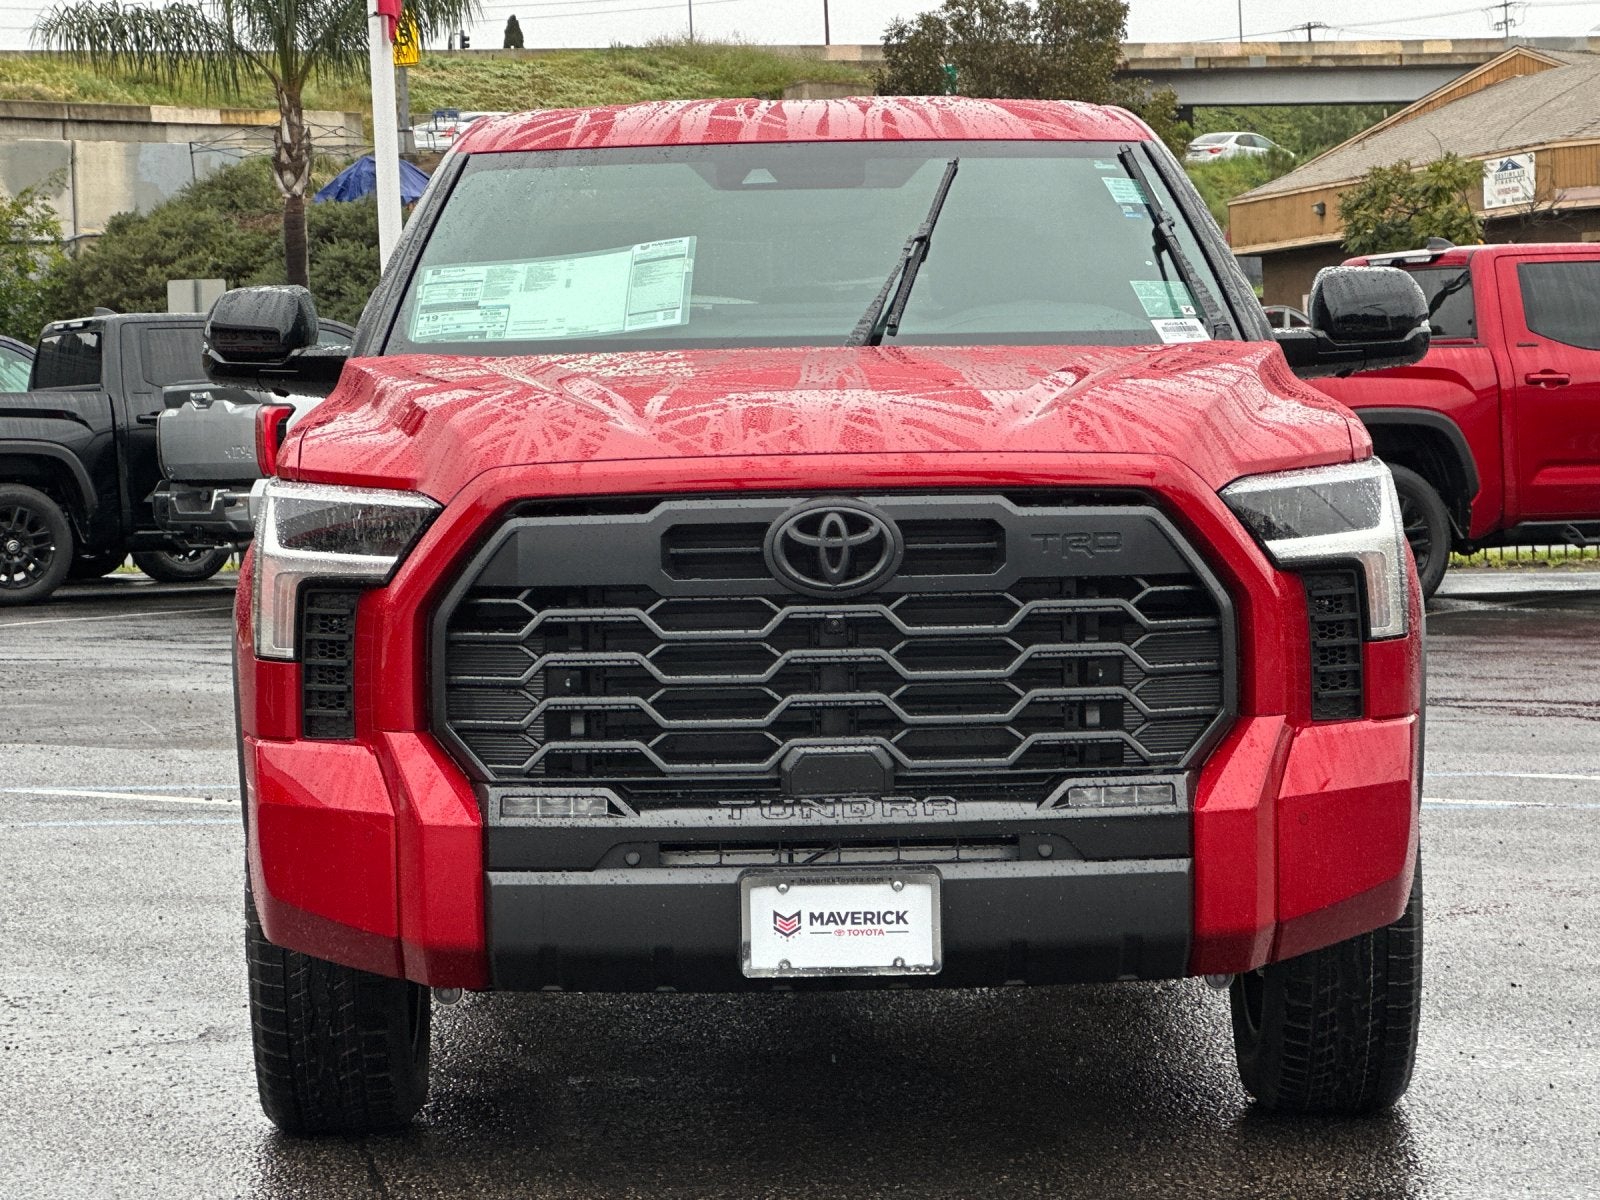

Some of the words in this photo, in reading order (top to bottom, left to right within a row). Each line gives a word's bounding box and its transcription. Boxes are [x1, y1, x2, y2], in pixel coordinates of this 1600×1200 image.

[1030, 531, 1122, 559] TRD
[718, 796, 957, 820] TUNDRA
[809, 910, 909, 926] MAVERICK
[847, 928, 885, 936] TOYOTA
